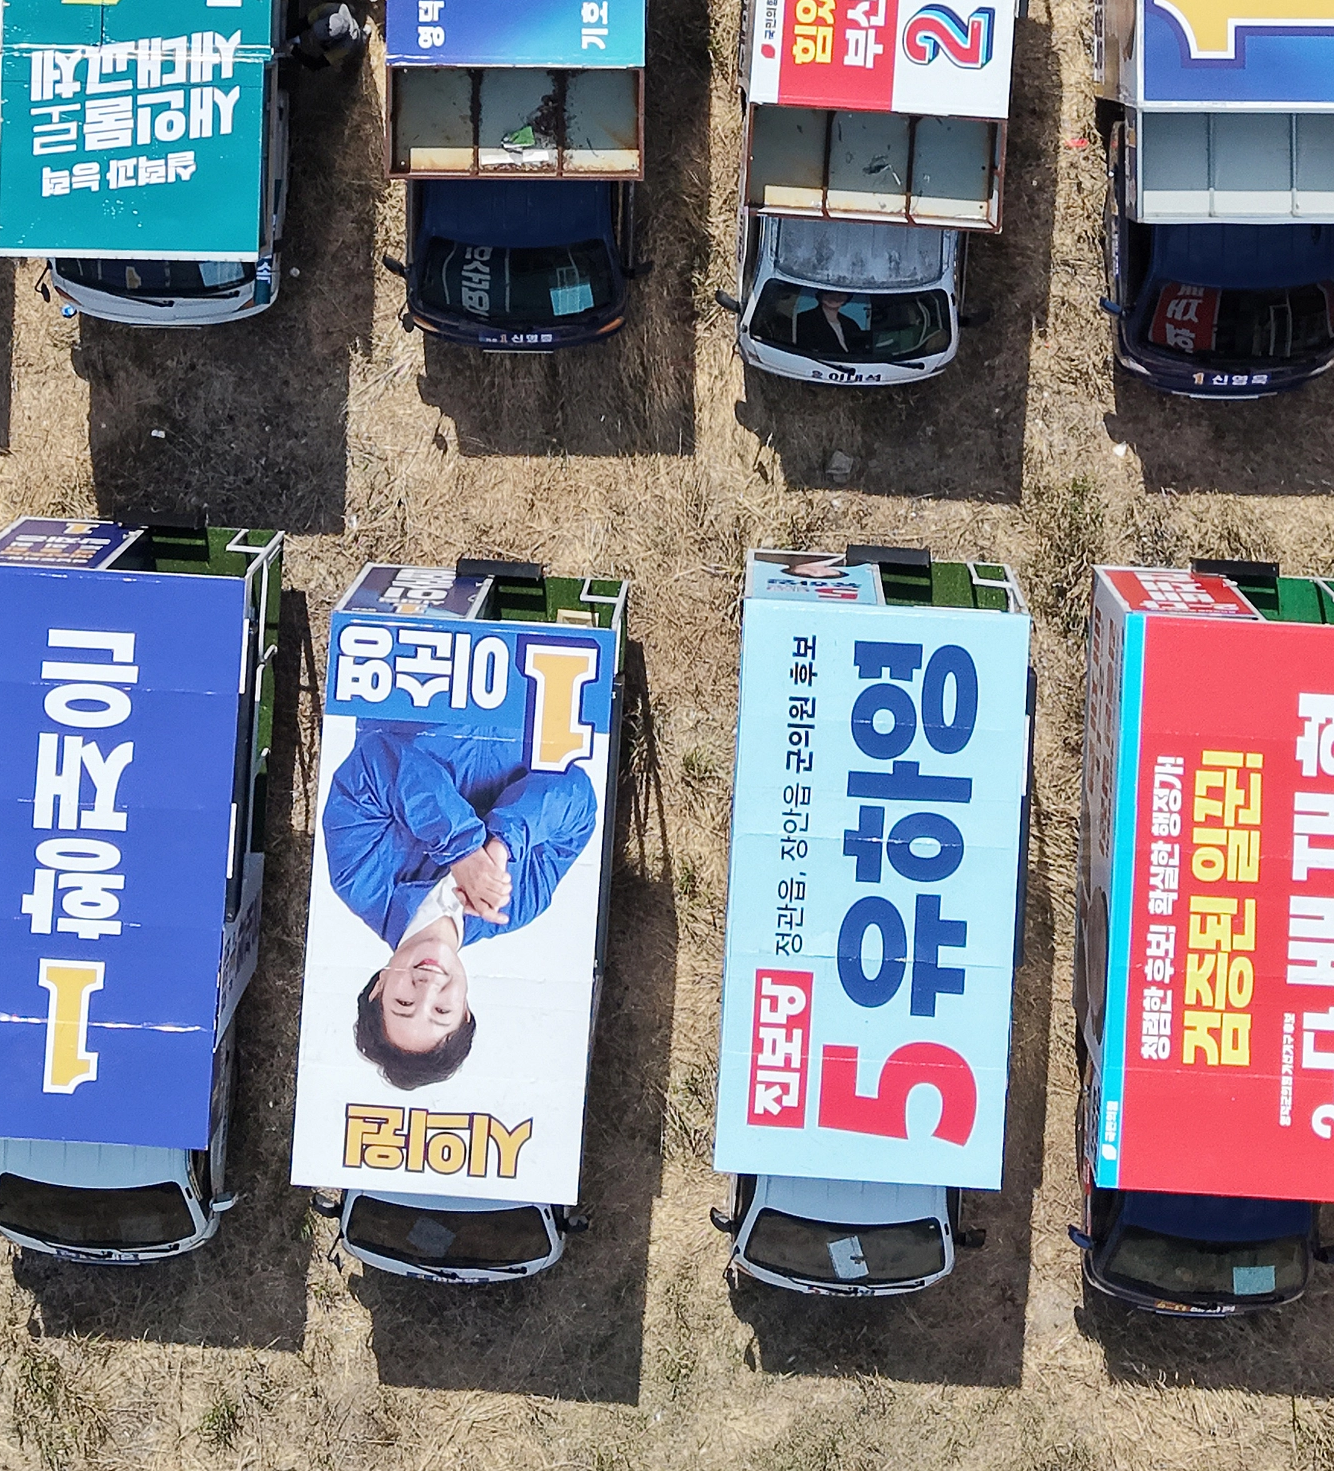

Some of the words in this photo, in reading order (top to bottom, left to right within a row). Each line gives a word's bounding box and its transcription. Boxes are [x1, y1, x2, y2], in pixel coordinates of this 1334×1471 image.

[581, 1, 610, 49] 기호
[903, 4, 994, 69] 2
[31, 85, 240, 155] 새인물로
[41, 165, 102, 196] 능력
[106, 150, 197, 186] 실력과
[334, 626, 510, 710] 이순영
[792, 635, 817, 688] 후보
[520, 638, 598, 774] 1
[786, 695, 815, 774] 군의원
[20, 627, 138, 941] 황재은
[780, 782, 810, 861] 장안읍
[1191, 751, 1264, 881] 일꾼!
[835, 641, 978, 1018] 유하영
[775, 871, 806, 957] 정관읍,
[1182, 897, 1256, 1065] 검증된
[37, 957, 105, 1095] 1
[752, 976, 800, 1116] 진보당
[817, 1041, 977, 1146] 5
[342, 1104, 532, 1179] 시의원
